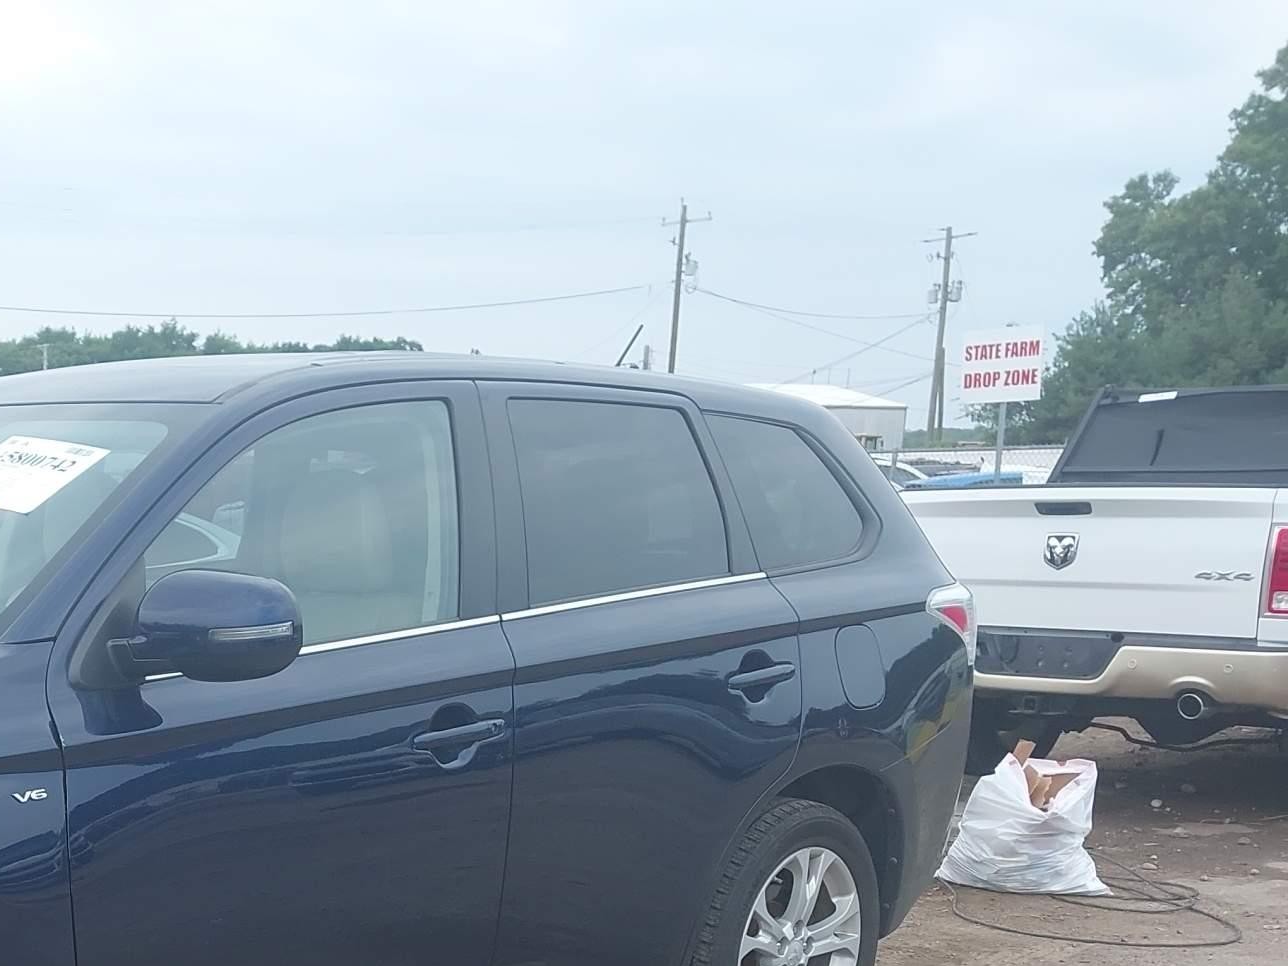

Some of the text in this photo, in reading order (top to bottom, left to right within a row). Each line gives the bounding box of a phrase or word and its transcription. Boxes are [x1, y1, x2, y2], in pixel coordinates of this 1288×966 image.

[964, 339, 1041, 362] STATE FARM
[963, 368, 1039, 389] DROP ZONE
[11, 788, 48, 803] V6
